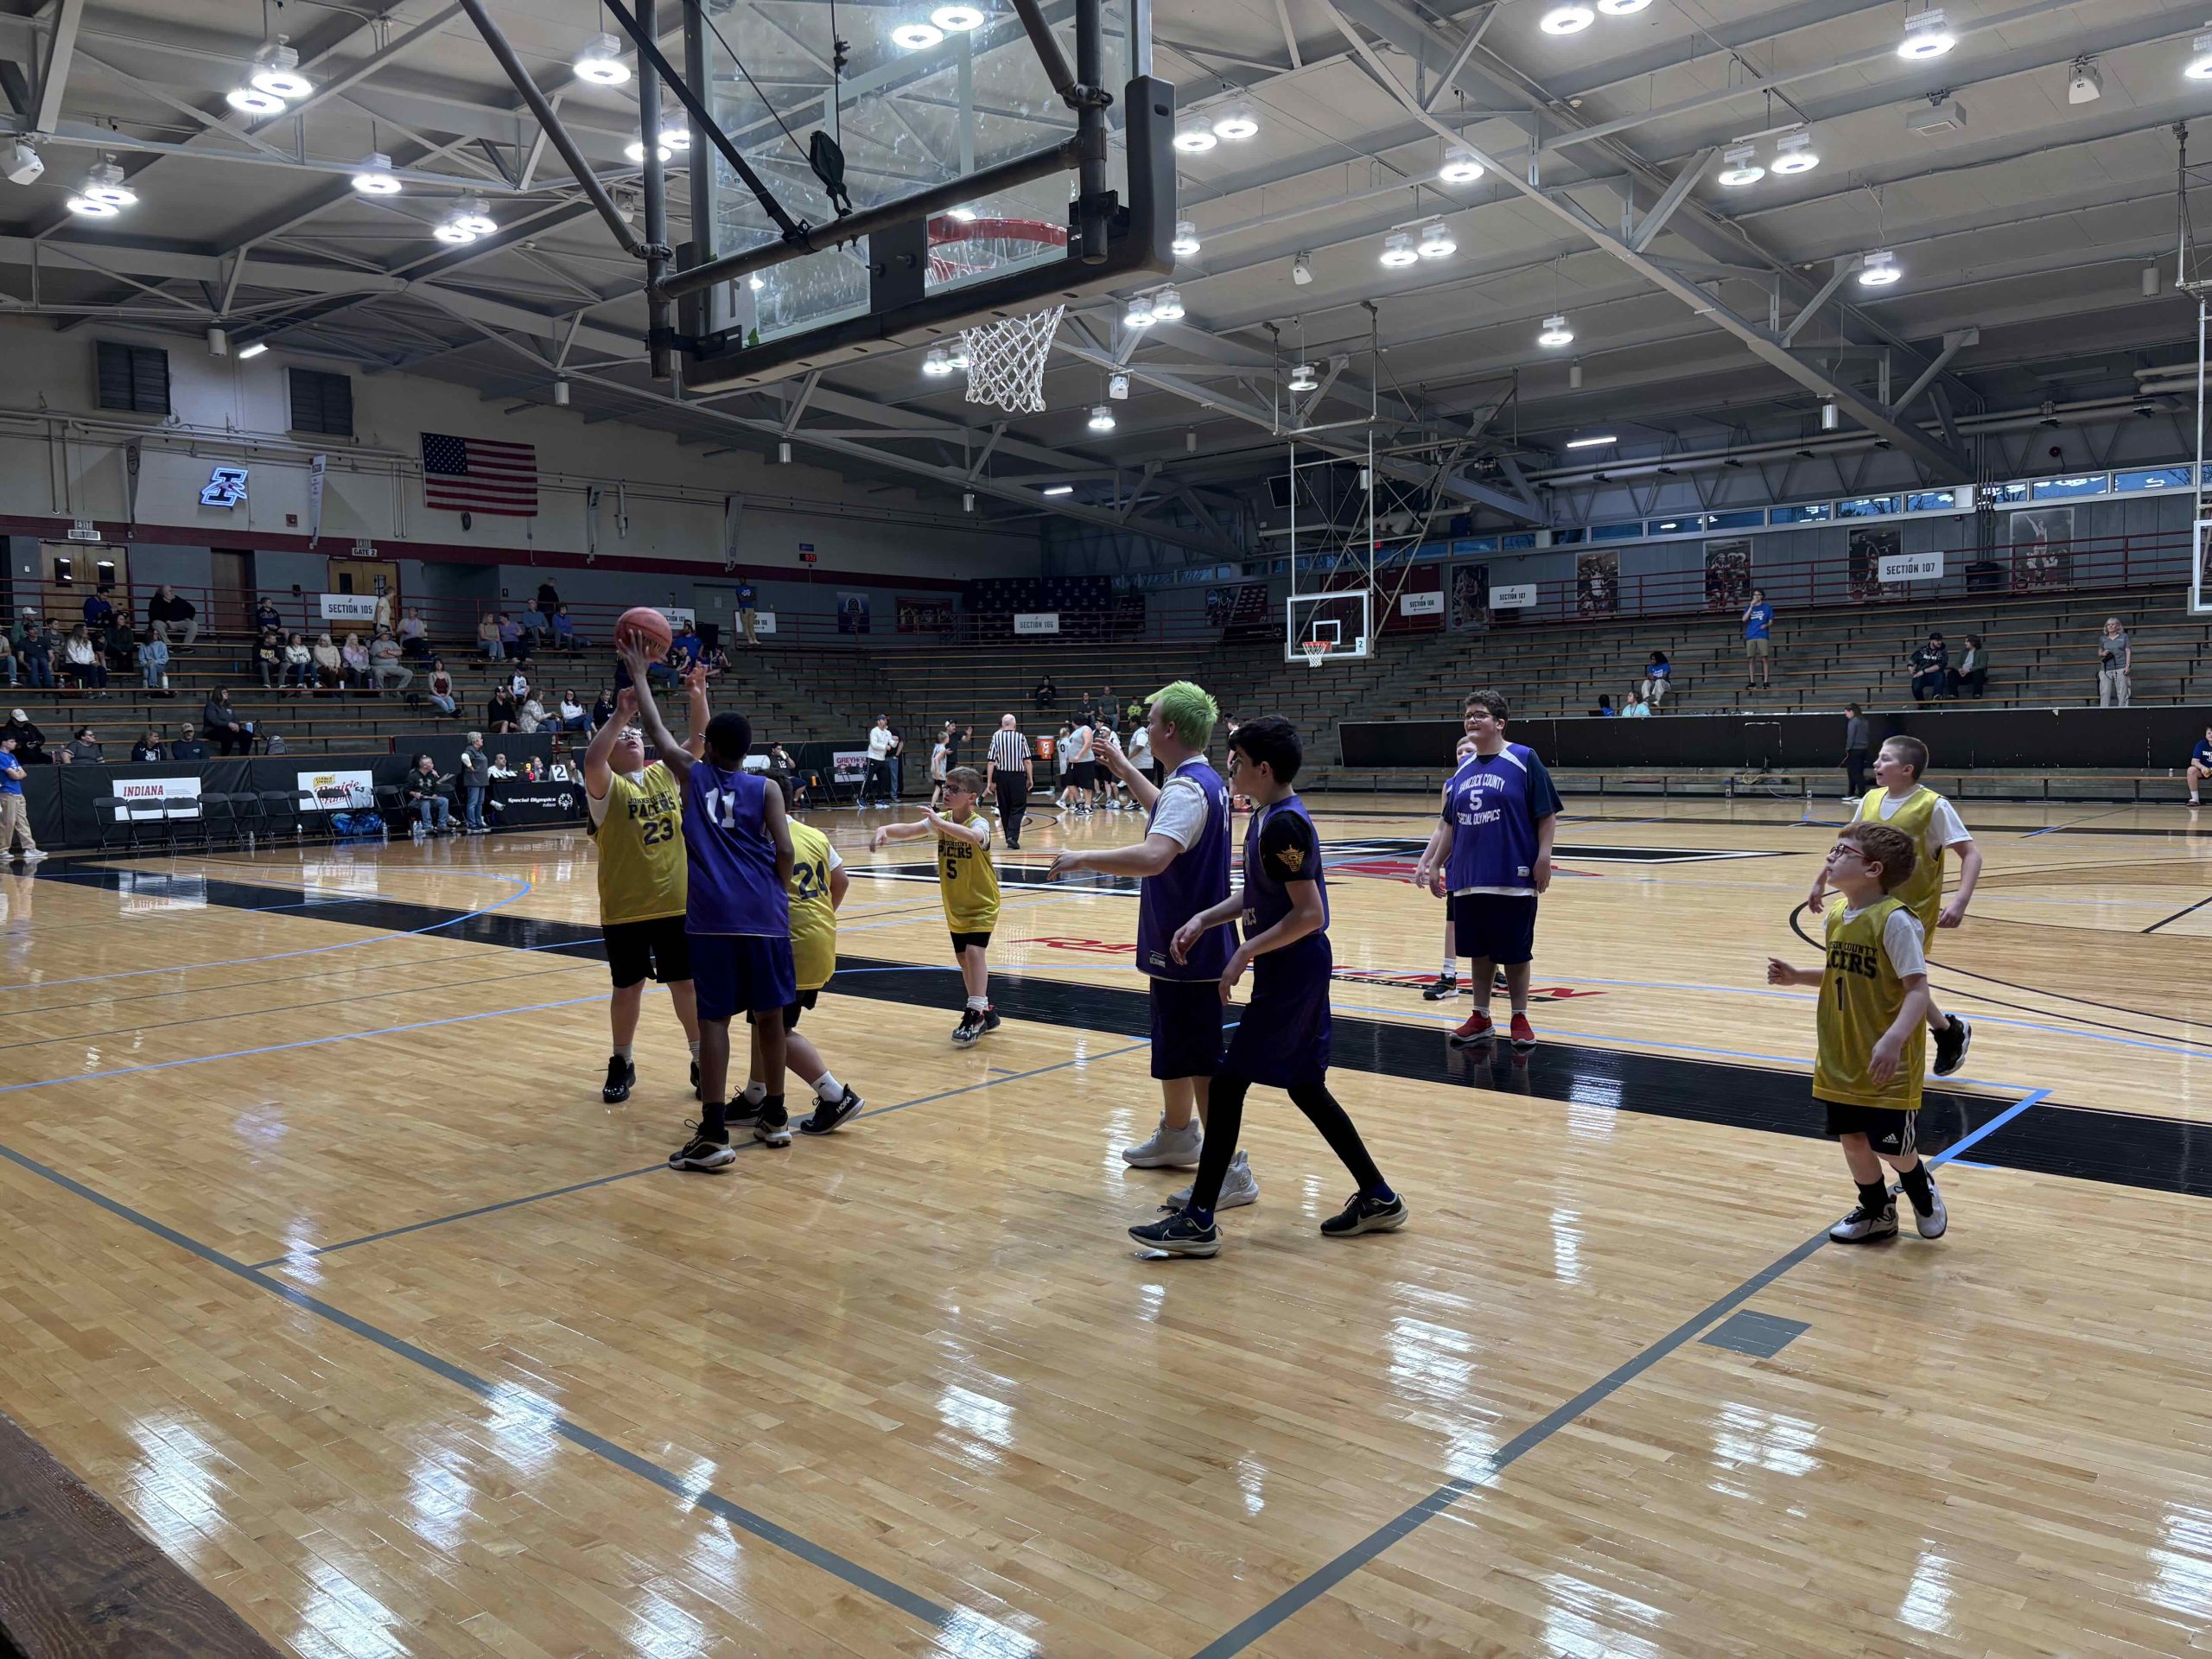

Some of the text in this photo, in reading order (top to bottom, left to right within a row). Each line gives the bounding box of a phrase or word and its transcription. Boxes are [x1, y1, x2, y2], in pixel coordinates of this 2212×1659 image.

[1886, 563, 1936, 575] SECTION 107
[328, 603, 373, 614] SECTION 105
[1059, 743, 1065, 753] 0
[554, 766, 566, 779] 2
[779, 760, 787, 769] 12
[124, 785, 164, 797] INDIANA
[1458, 773, 1506, 795] HANCOCK COUNTY
[705, 787, 735, 828] 11
[1469, 789, 1484, 810] 5
[628, 796, 677, 820] PACERS
[1473, 809, 1501, 825] OLYMPICS
[643, 817, 674, 846] 23
[947, 859, 957, 880] 5
[1844, 942, 1878, 957] COUNTY
[1834, 976, 1844, 1011] 1
